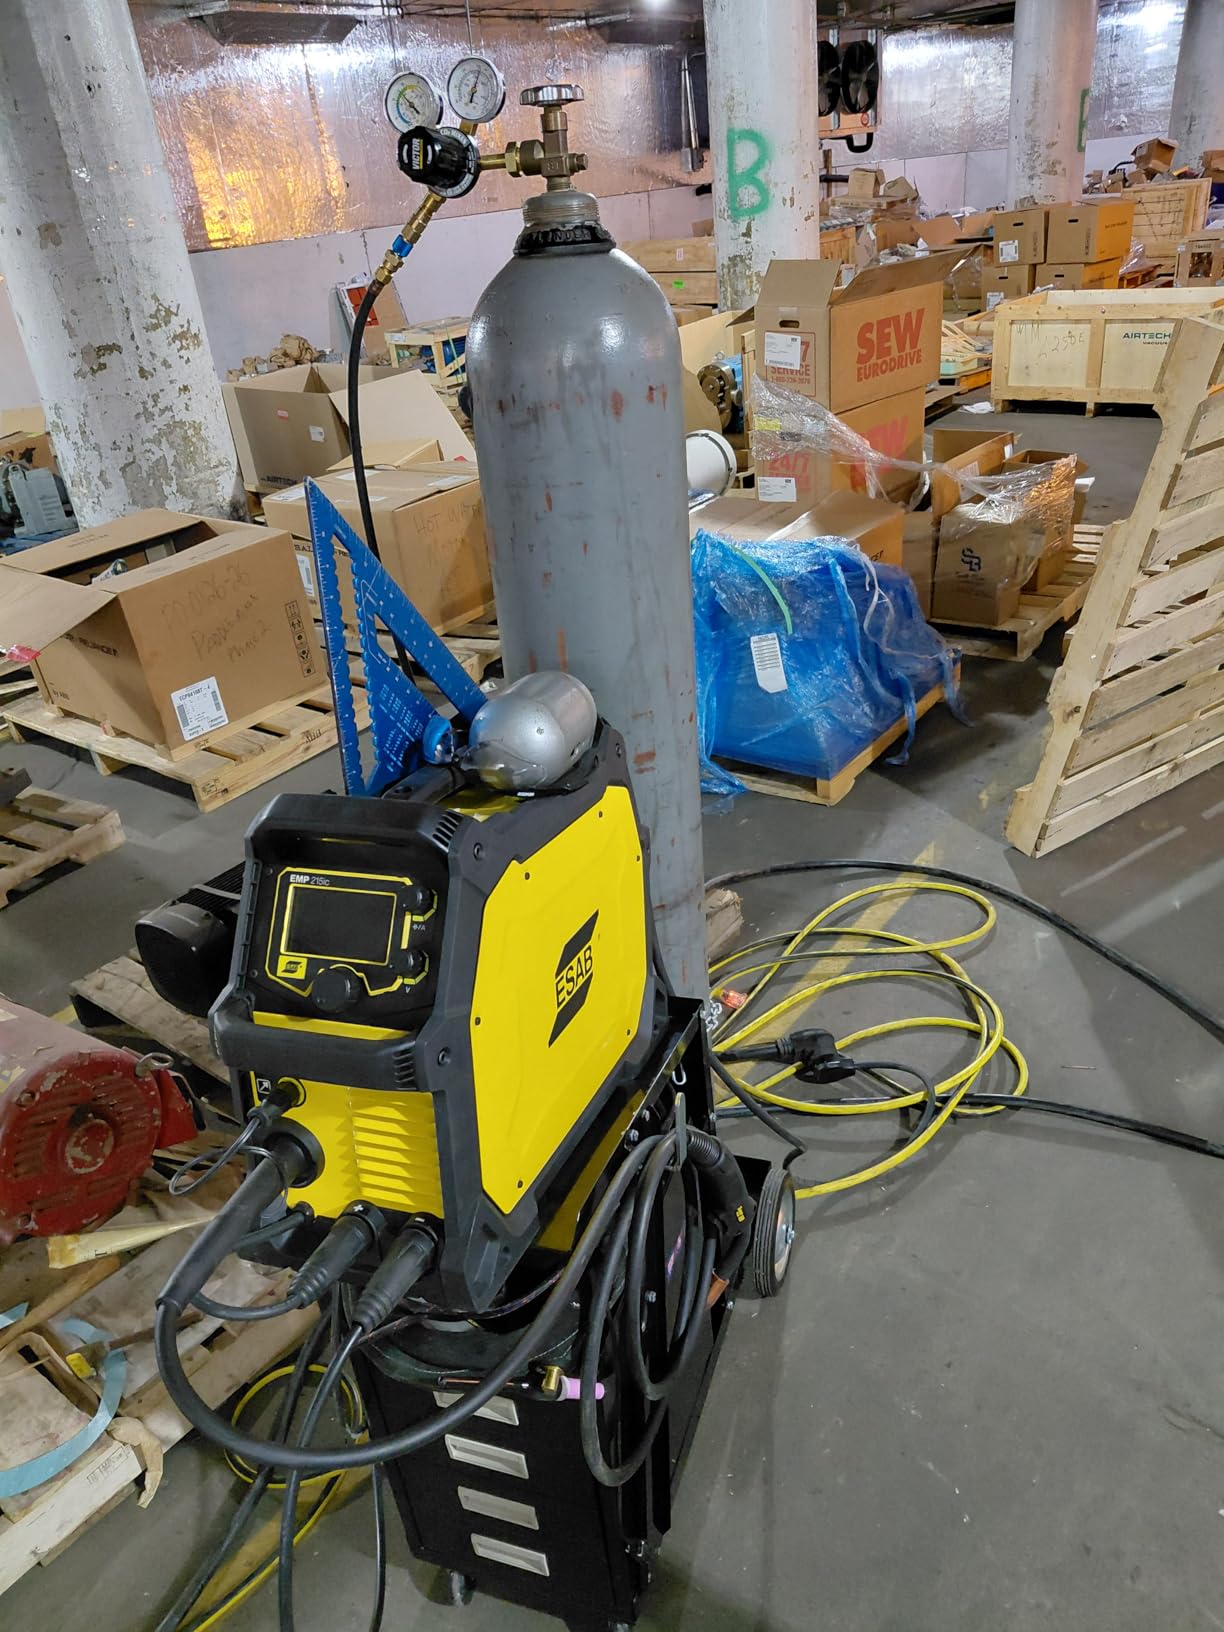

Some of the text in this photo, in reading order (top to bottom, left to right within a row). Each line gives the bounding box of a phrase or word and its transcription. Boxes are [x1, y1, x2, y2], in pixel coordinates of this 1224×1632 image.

[411, 138, 421, 170] VICTOR
[727, 128, 769, 219] B
[857, 308, 925, 365] SEW
[857, 348, 922, 383] EURODRIVE
[290, 874, 310, 884] EMP
[555, 944, 593, 1010] ESAB
